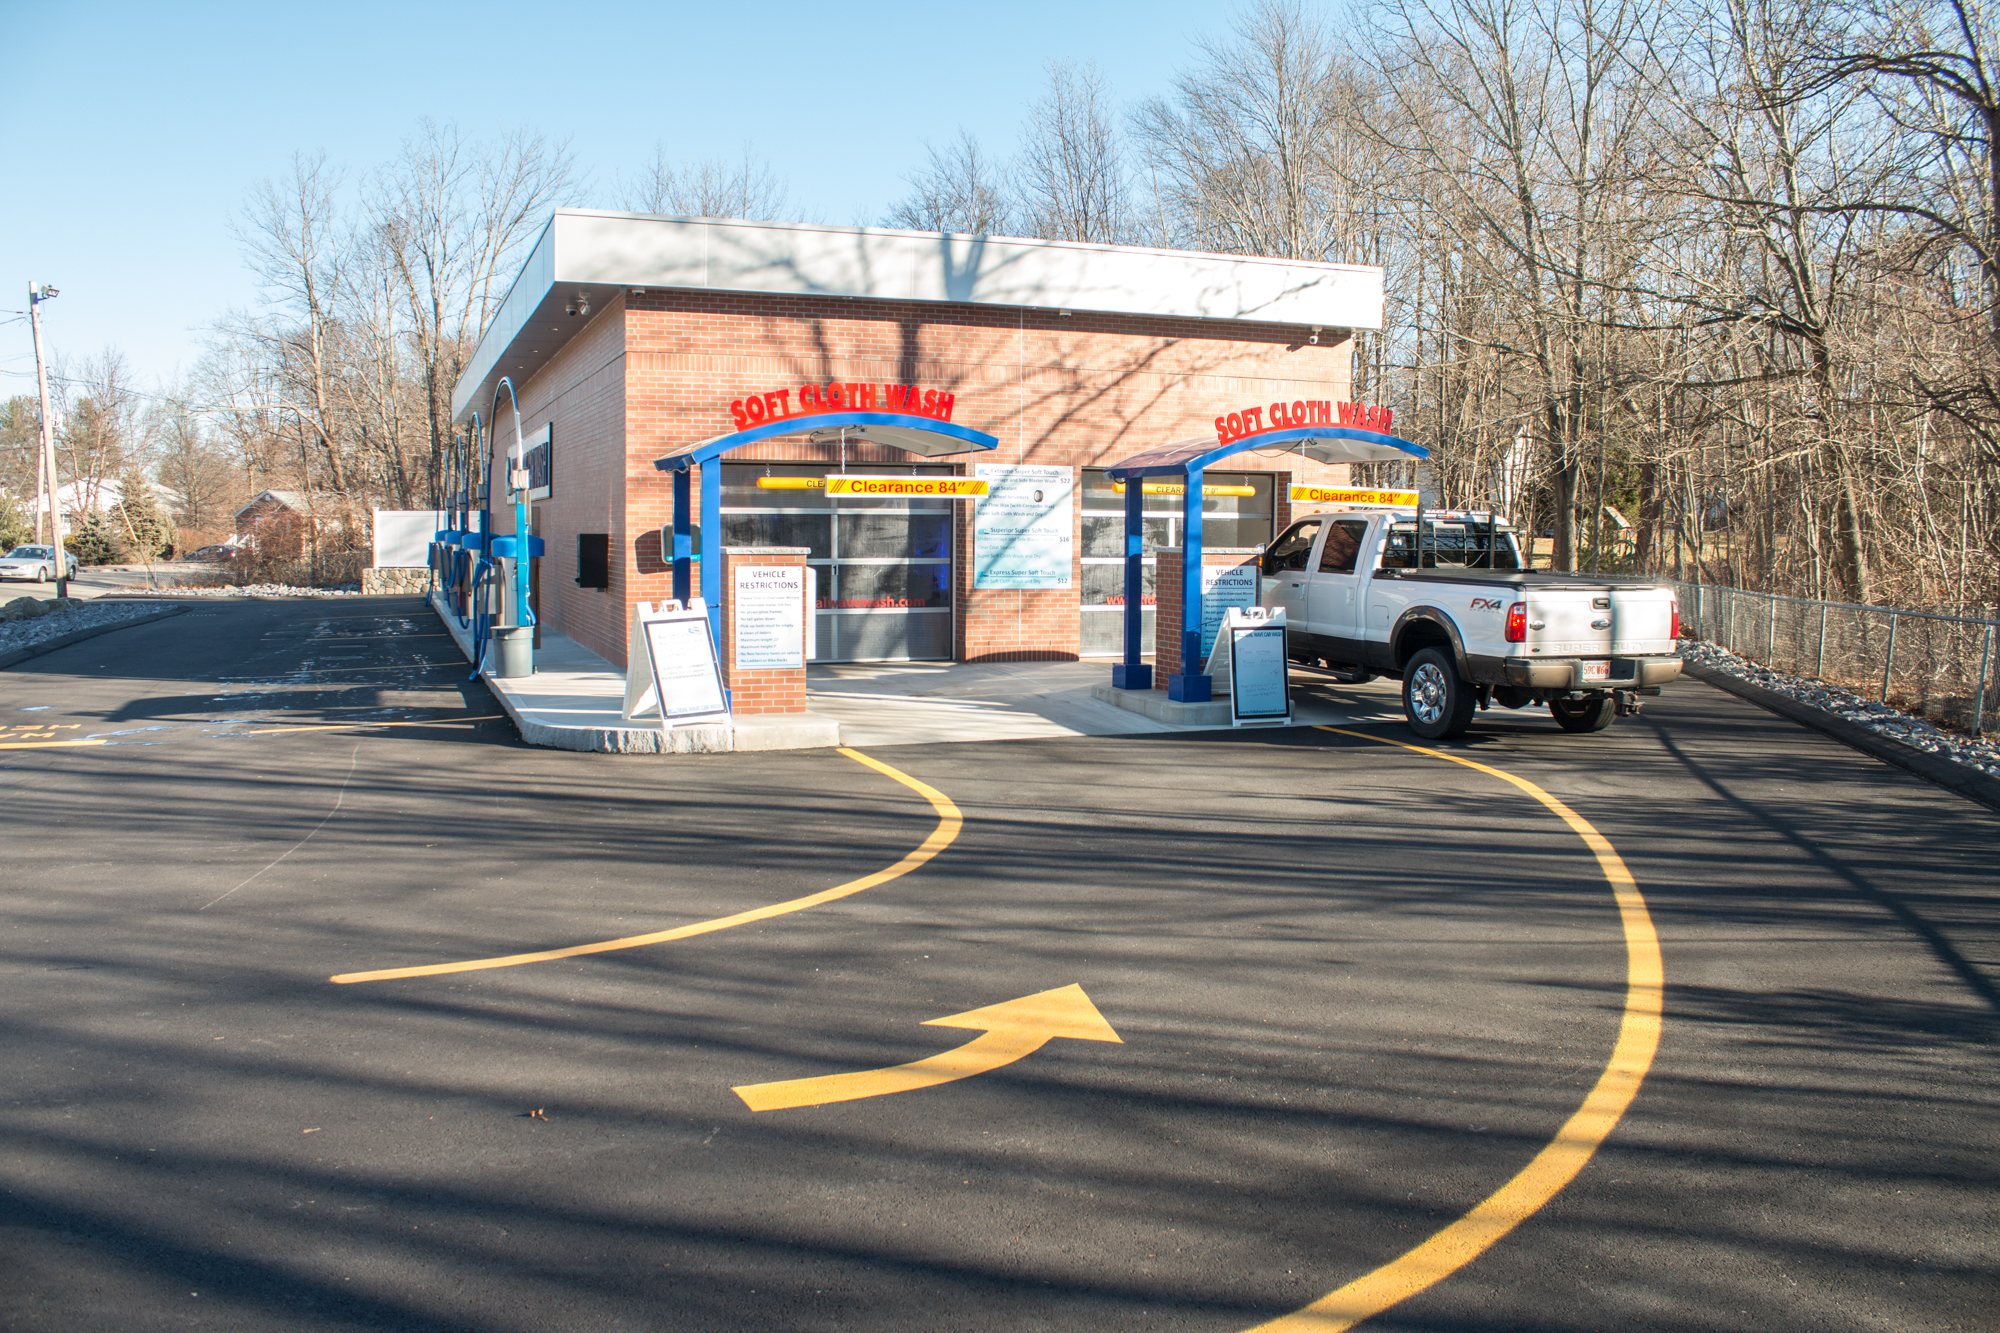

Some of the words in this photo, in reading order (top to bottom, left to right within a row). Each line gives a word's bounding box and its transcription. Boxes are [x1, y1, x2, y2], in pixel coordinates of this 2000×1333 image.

[730, 389, 790, 430] SOFT
[799, 382, 877, 410] CLOTH
[884, 384, 955, 422] WASH
[1215, 406, 1263, 443] SOFT
[1269, 400, 1331, 426] CLOTH
[1337, 401, 1393, 434] WASH
[851, 480, 933, 493] Clearance
[1309, 489, 1375, 503] Clearance
[752, 570, 786, 578] VEHICLE
[740, 581, 798, 589] RESTRICTIONS
[816, 595, 925, 608] alwavewash.com
[1470, 598, 1503, 610] FX4
[1551, 643, 1600, 654] SUPER
[1584, 665, 1596, 675] 59C
